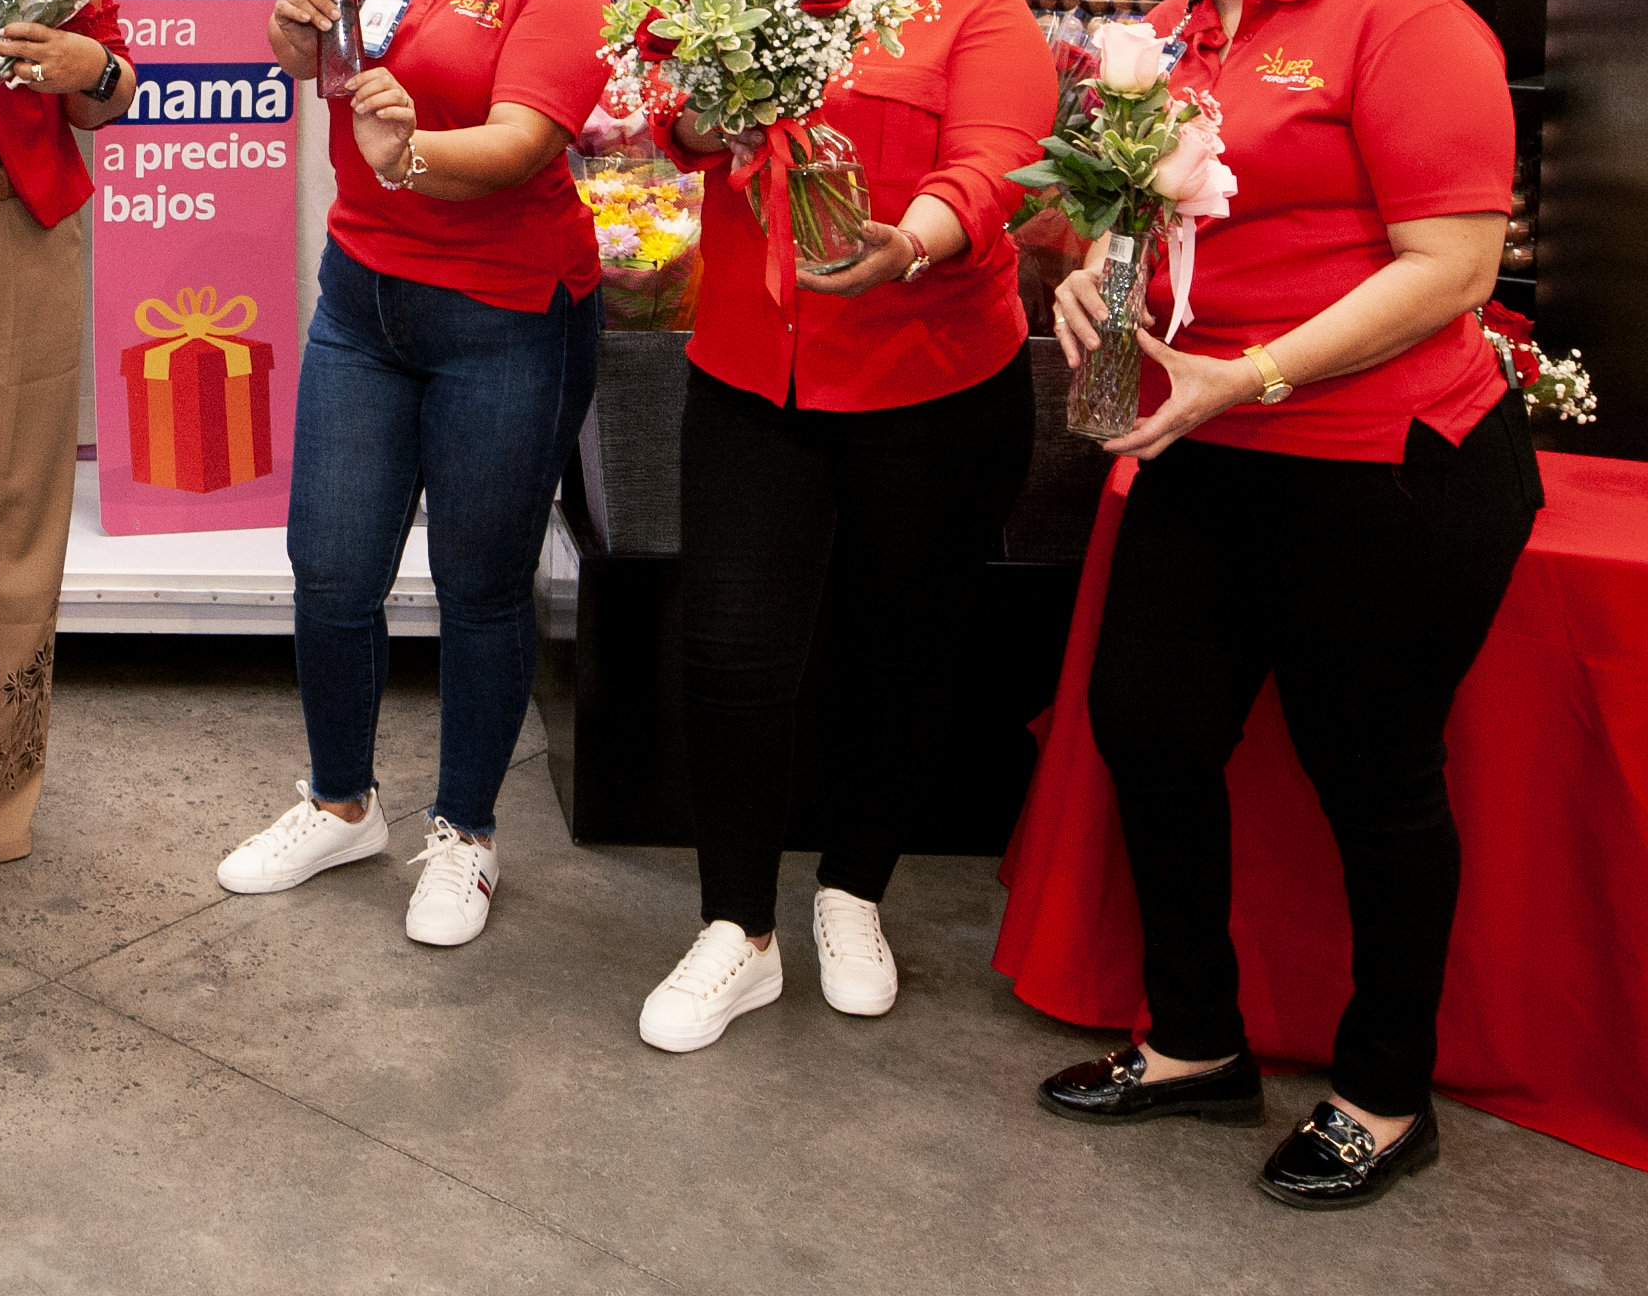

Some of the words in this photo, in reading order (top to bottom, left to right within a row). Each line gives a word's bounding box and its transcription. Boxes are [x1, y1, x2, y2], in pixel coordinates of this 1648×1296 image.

[1265, 58, 1314, 76] SUPER
[103, 143, 125, 171] a
[135, 133, 287, 178] precios
[103, 185, 216, 229] bajos
